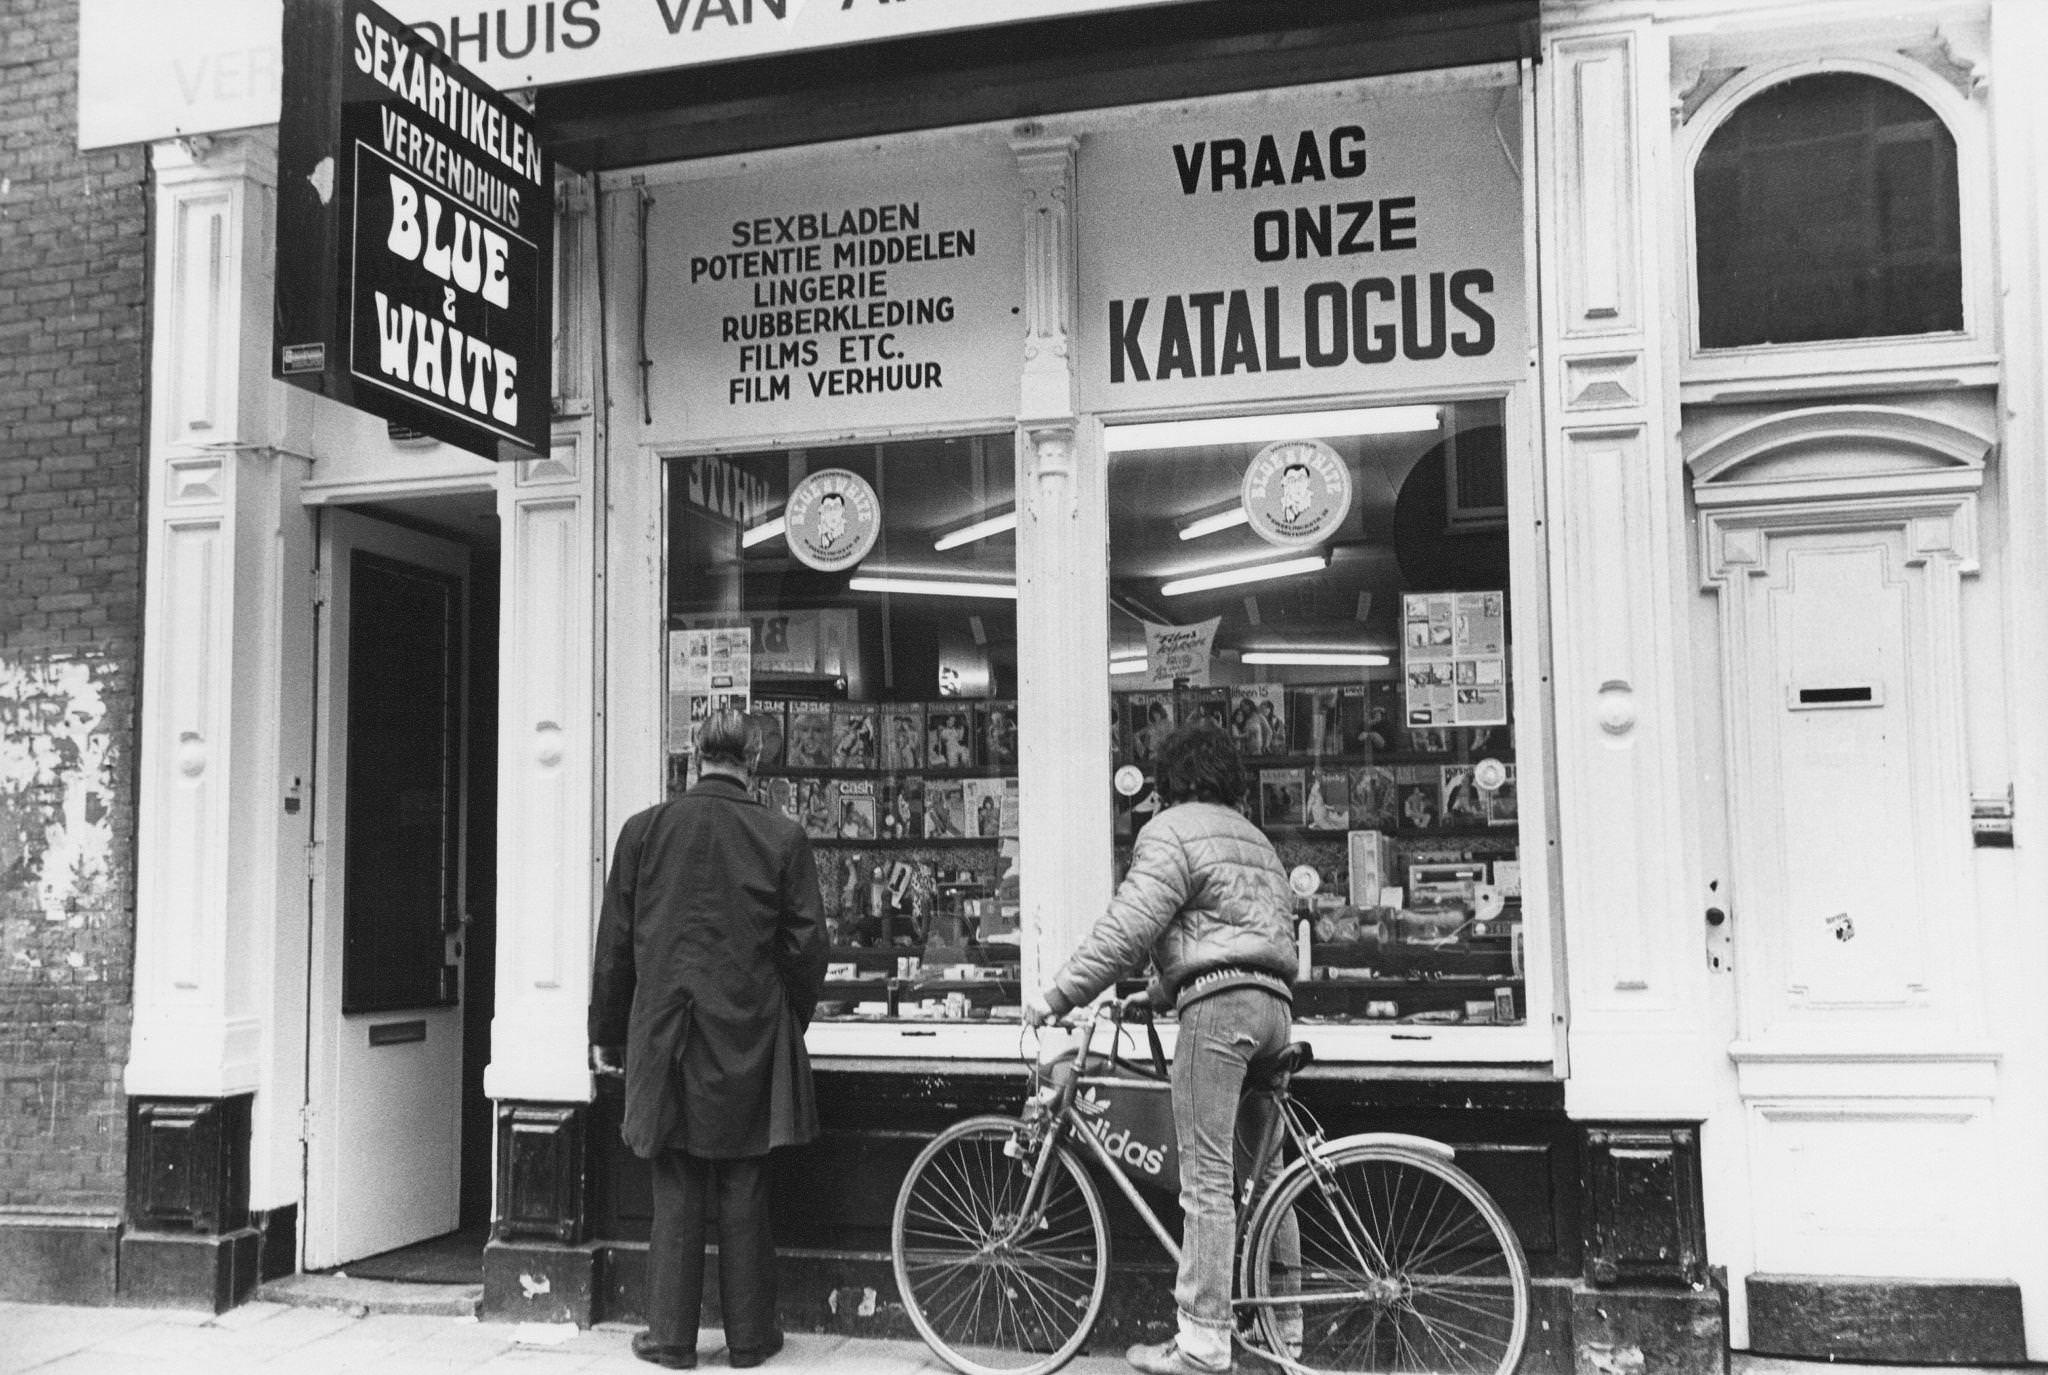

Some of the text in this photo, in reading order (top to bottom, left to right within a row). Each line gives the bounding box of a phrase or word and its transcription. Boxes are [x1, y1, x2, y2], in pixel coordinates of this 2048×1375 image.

[354, 12, 541, 186] SEXARTIKELEN
[381, 104, 519, 228] VERZENDHUIS
[1173, 125, 1367, 195] VRAAG
[387, 173, 509, 309] BLUE
[732, 202, 920, 248] SEXBLADEN
[1253, 196, 1417, 262] ONZE
[691, 229, 976, 283] POTENTIE MIDDELEN
[442, 285, 456, 323] &
[754, 271, 887, 308] LINGERIE
[722, 297, 955, 342] RUBBERKLEDING
[1109, 268, 1495, 383] KATALOGUS
[374, 290, 518, 427] WHITE
[729, 361, 943, 404] FILM VERHUUR
[740, 334, 905, 373] FILMS ETC.
[1069, 1117, 1165, 1175] didas
